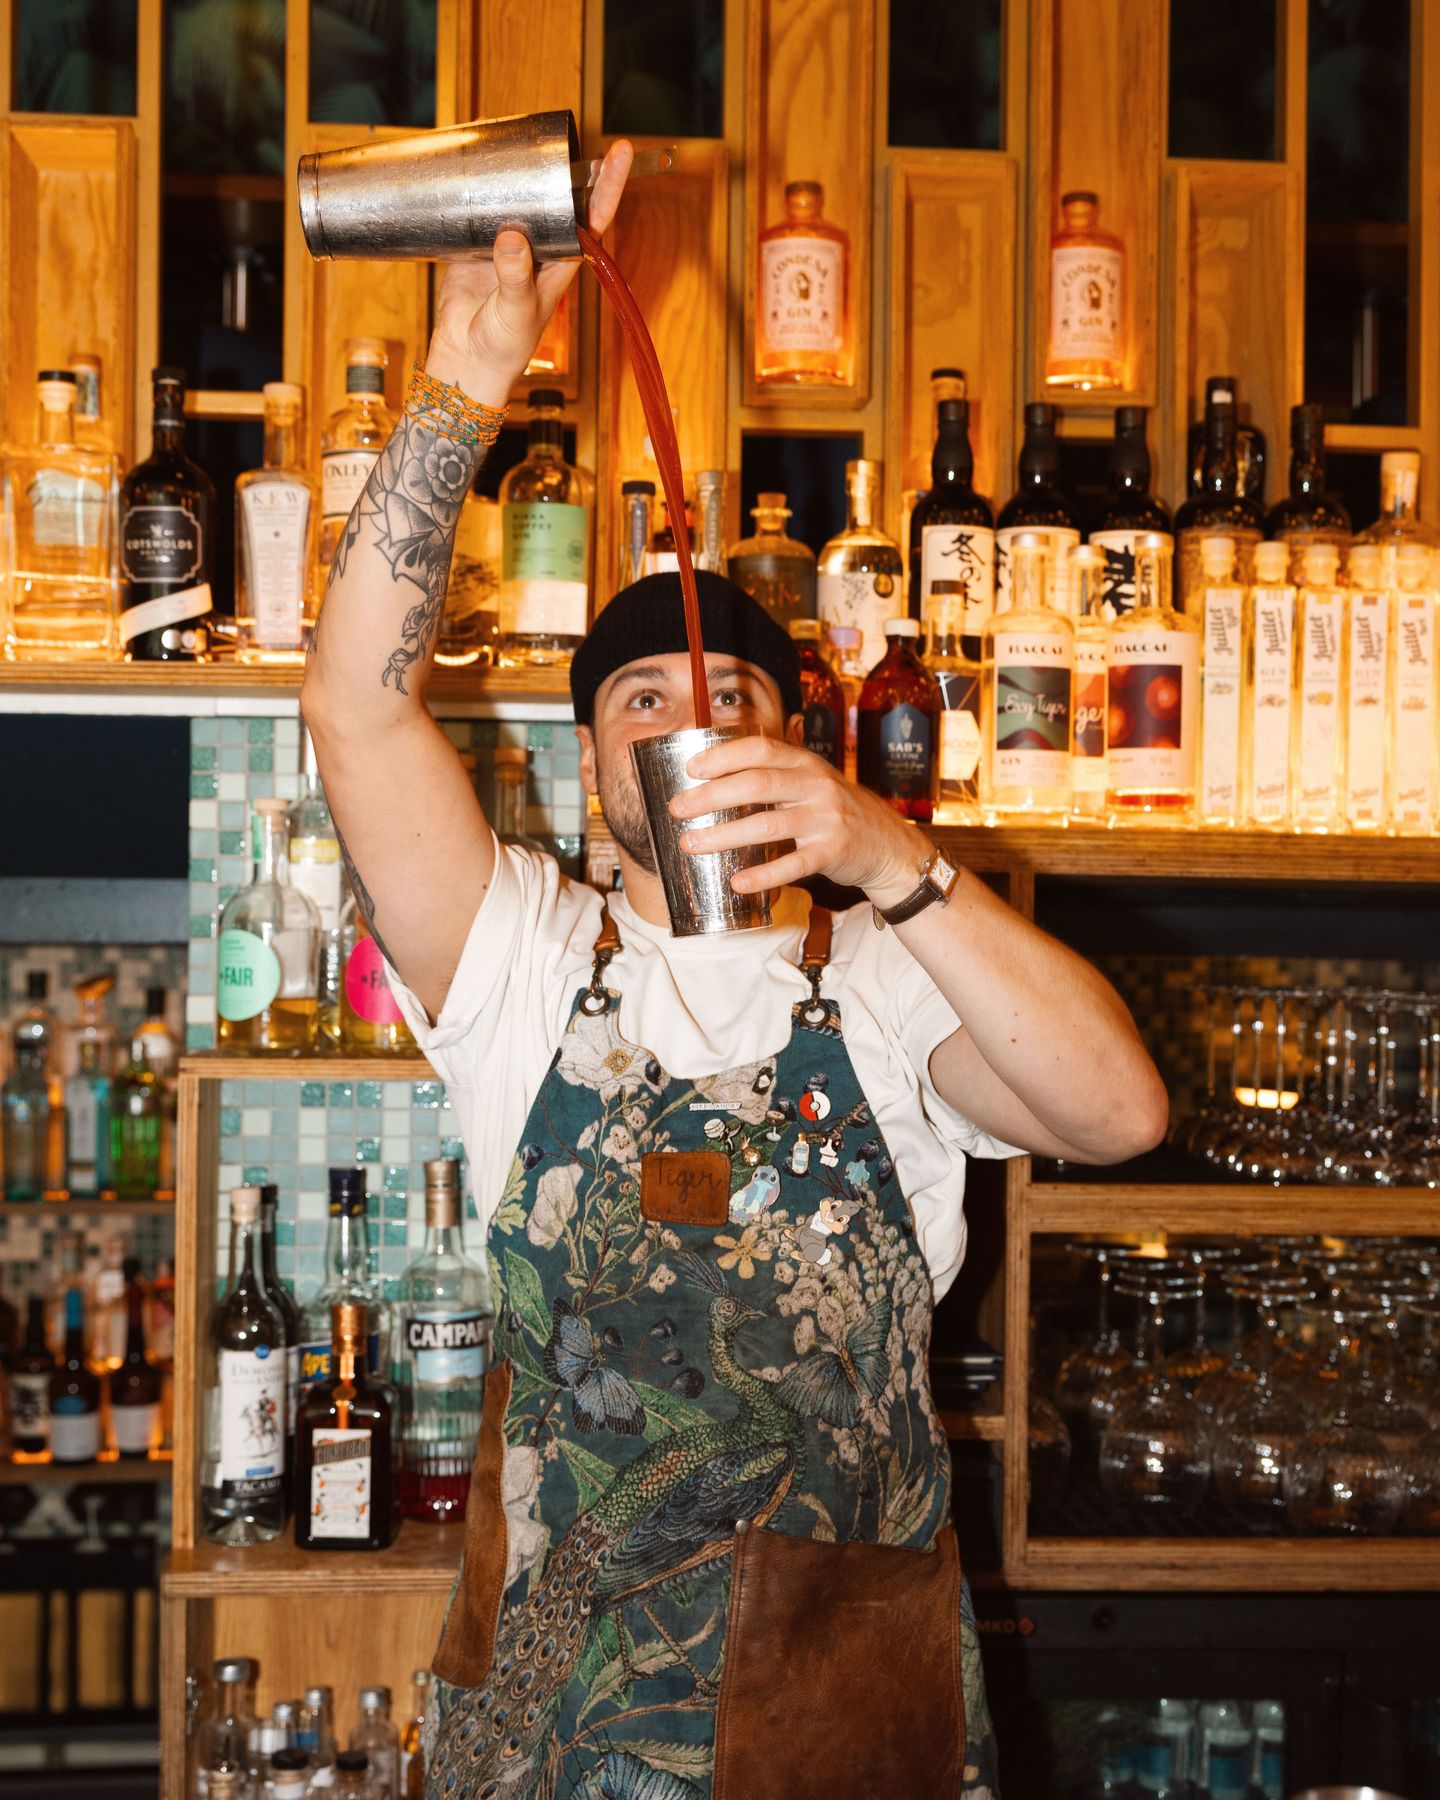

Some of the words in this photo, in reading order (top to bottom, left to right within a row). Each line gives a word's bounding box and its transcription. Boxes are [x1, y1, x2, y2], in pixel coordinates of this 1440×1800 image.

[251, 490, 299, 504] KEW
[887, 741, 924, 753] SAB'S
[223, 967, 254, 986] FAIR
[652, 1157, 722, 1204] Tiger
